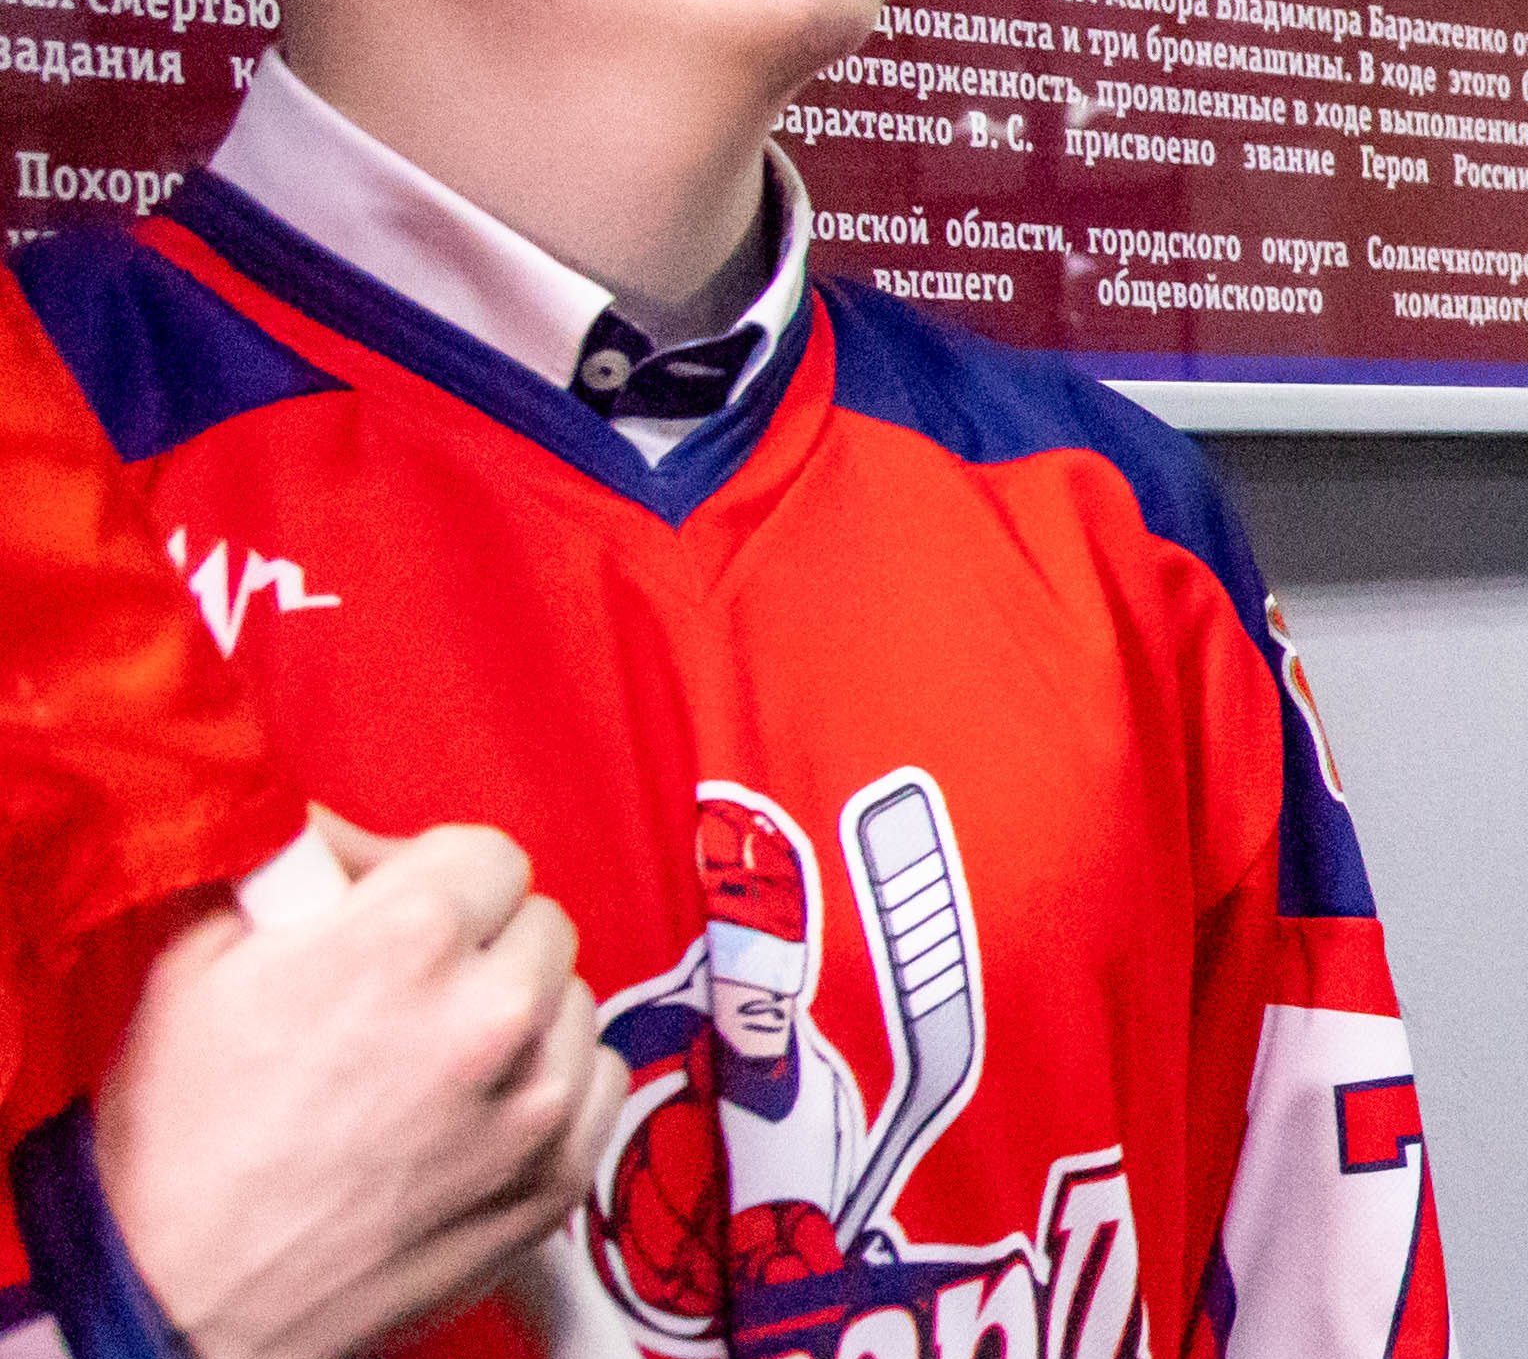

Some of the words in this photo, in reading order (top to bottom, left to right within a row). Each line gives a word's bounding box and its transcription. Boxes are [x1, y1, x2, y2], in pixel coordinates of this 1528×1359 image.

[1367, 4, 1508, 55] Барахтенко
[1062, 24, 1082, 54] и
[1088, 28, 1140, 67] три
[1147, 23, 1354, 84] бронемашины.
[1359, 50, 1376, 86] В
[1380, 59, 1438, 97] ходе
[1447, 67, 1511, 100] этого
[1096, 80, 1286, 125] проявленные
[1294, 100, 1309, 125] в
[1314, 102, 1373, 137] ходе
[969, 110, 998, 147] В.
[1006, 113, 1034, 153] С.
[1065, 125, 1217, 167] присвоено
[1243, 143, 1335, 177] звание
[1360, 144, 1430, 190] Героя
[945, 208, 1073, 256] области,
[1087, 226, 1242, 267] городского
[1261, 238, 1349, 275] округа
[872, 267, 1015, 302] высшего
[1097, 268, 1325, 316] общевойскового
